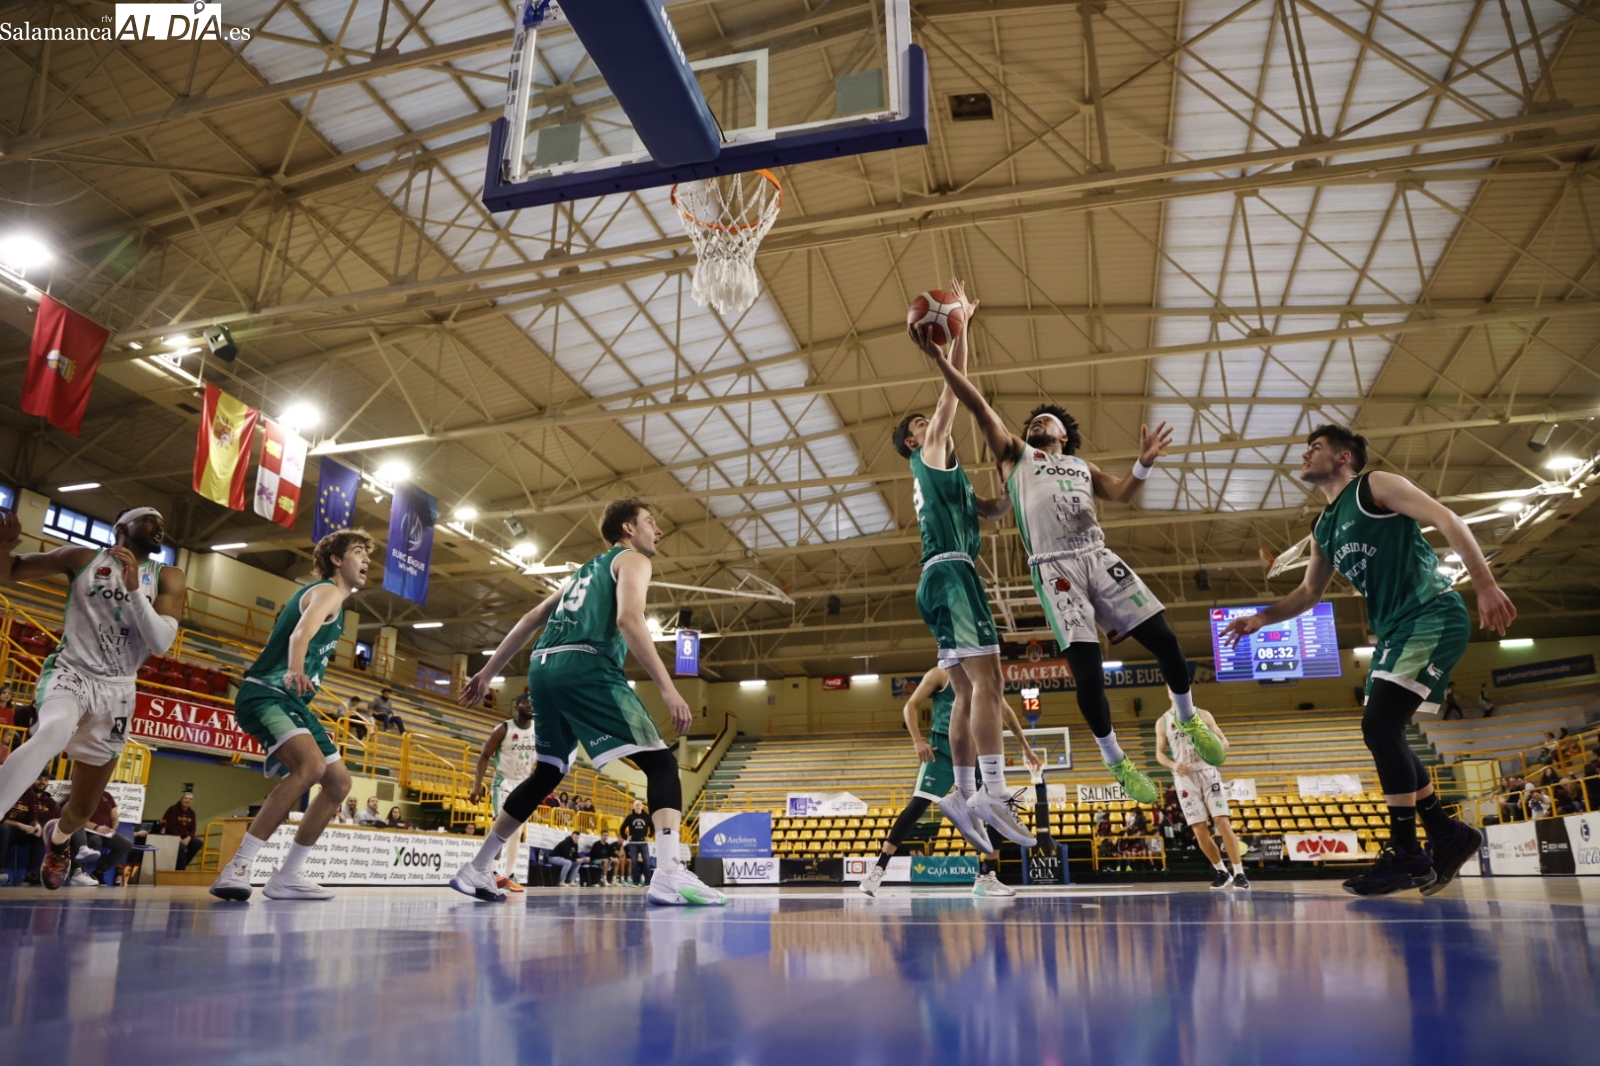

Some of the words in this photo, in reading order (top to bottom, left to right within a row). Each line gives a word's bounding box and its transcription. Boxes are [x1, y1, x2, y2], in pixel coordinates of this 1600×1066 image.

[1034, 464, 1090, 482] Xoborg
[392, 548, 425, 571] EUROEAGUE
[683, 640, 692, 656] 8
[1258, 647, 1294, 659] 08:32
[1007, 665, 1069, 681] GACETA
[1115, 670, 1134, 685] DE
[1023, 699, 1040, 710] 12
[214, 732, 234, 749] DE
[237, 736, 253, 752] LA
[394, 846, 441, 871] Xoborg
[1028, 847, 1046, 858] LA
[724, 861, 766, 880] MyMe
[927, 866, 948, 876] CAJA
[950, 866, 977, 875] RURAL
[1029, 868, 1055, 879] GUA
